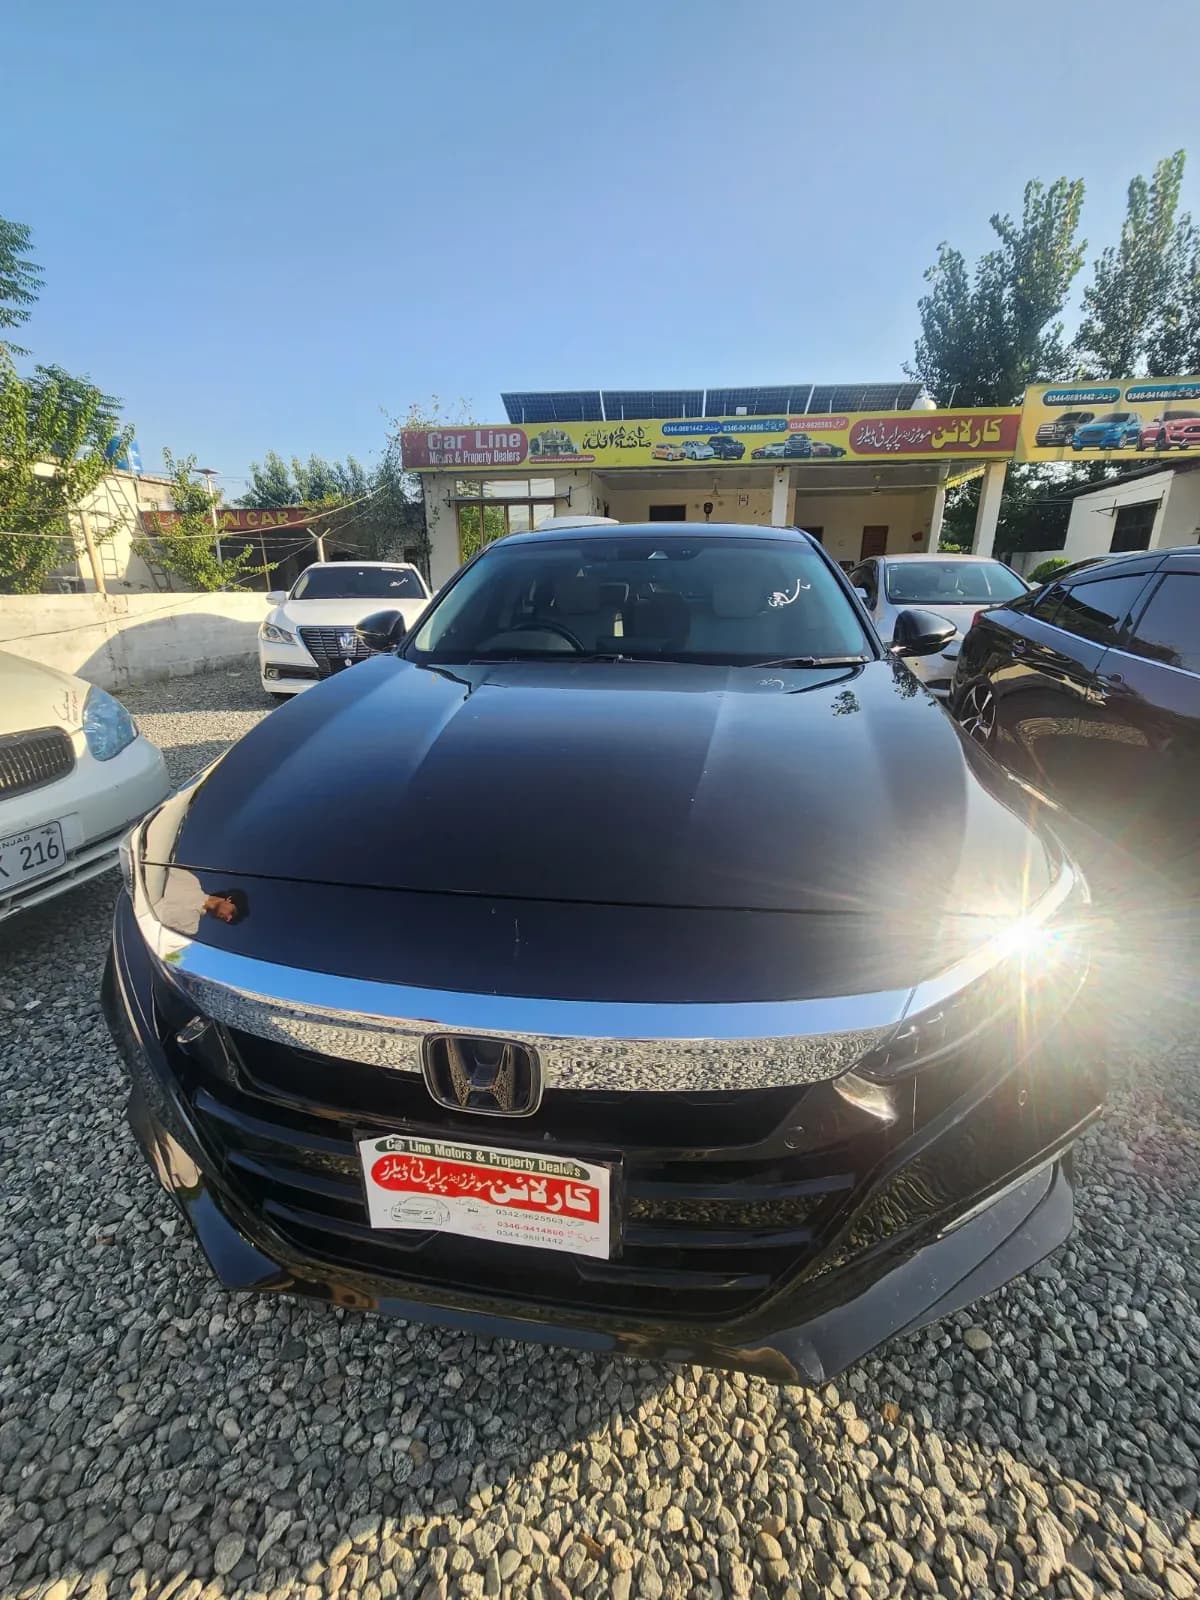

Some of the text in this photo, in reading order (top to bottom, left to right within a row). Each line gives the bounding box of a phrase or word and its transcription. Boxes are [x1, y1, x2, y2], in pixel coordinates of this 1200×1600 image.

[428, 430, 521, 450] Car Line
[429, 450, 454, 465] Mors
[455, 450, 461, 464] &
[463, 450, 492, 465] Property
[493, 449, 521, 463] Dealers
[246, 511, 289, 526] CAR
[0, 835, 31, 850] NJAB
[20, 836, 60, 871] 216
[409, 1140, 431, 1154] Line
[434, 1144, 472, 1161] Motors
[476, 1149, 486, 1162] &
[489, 1152, 535, 1174] Property
